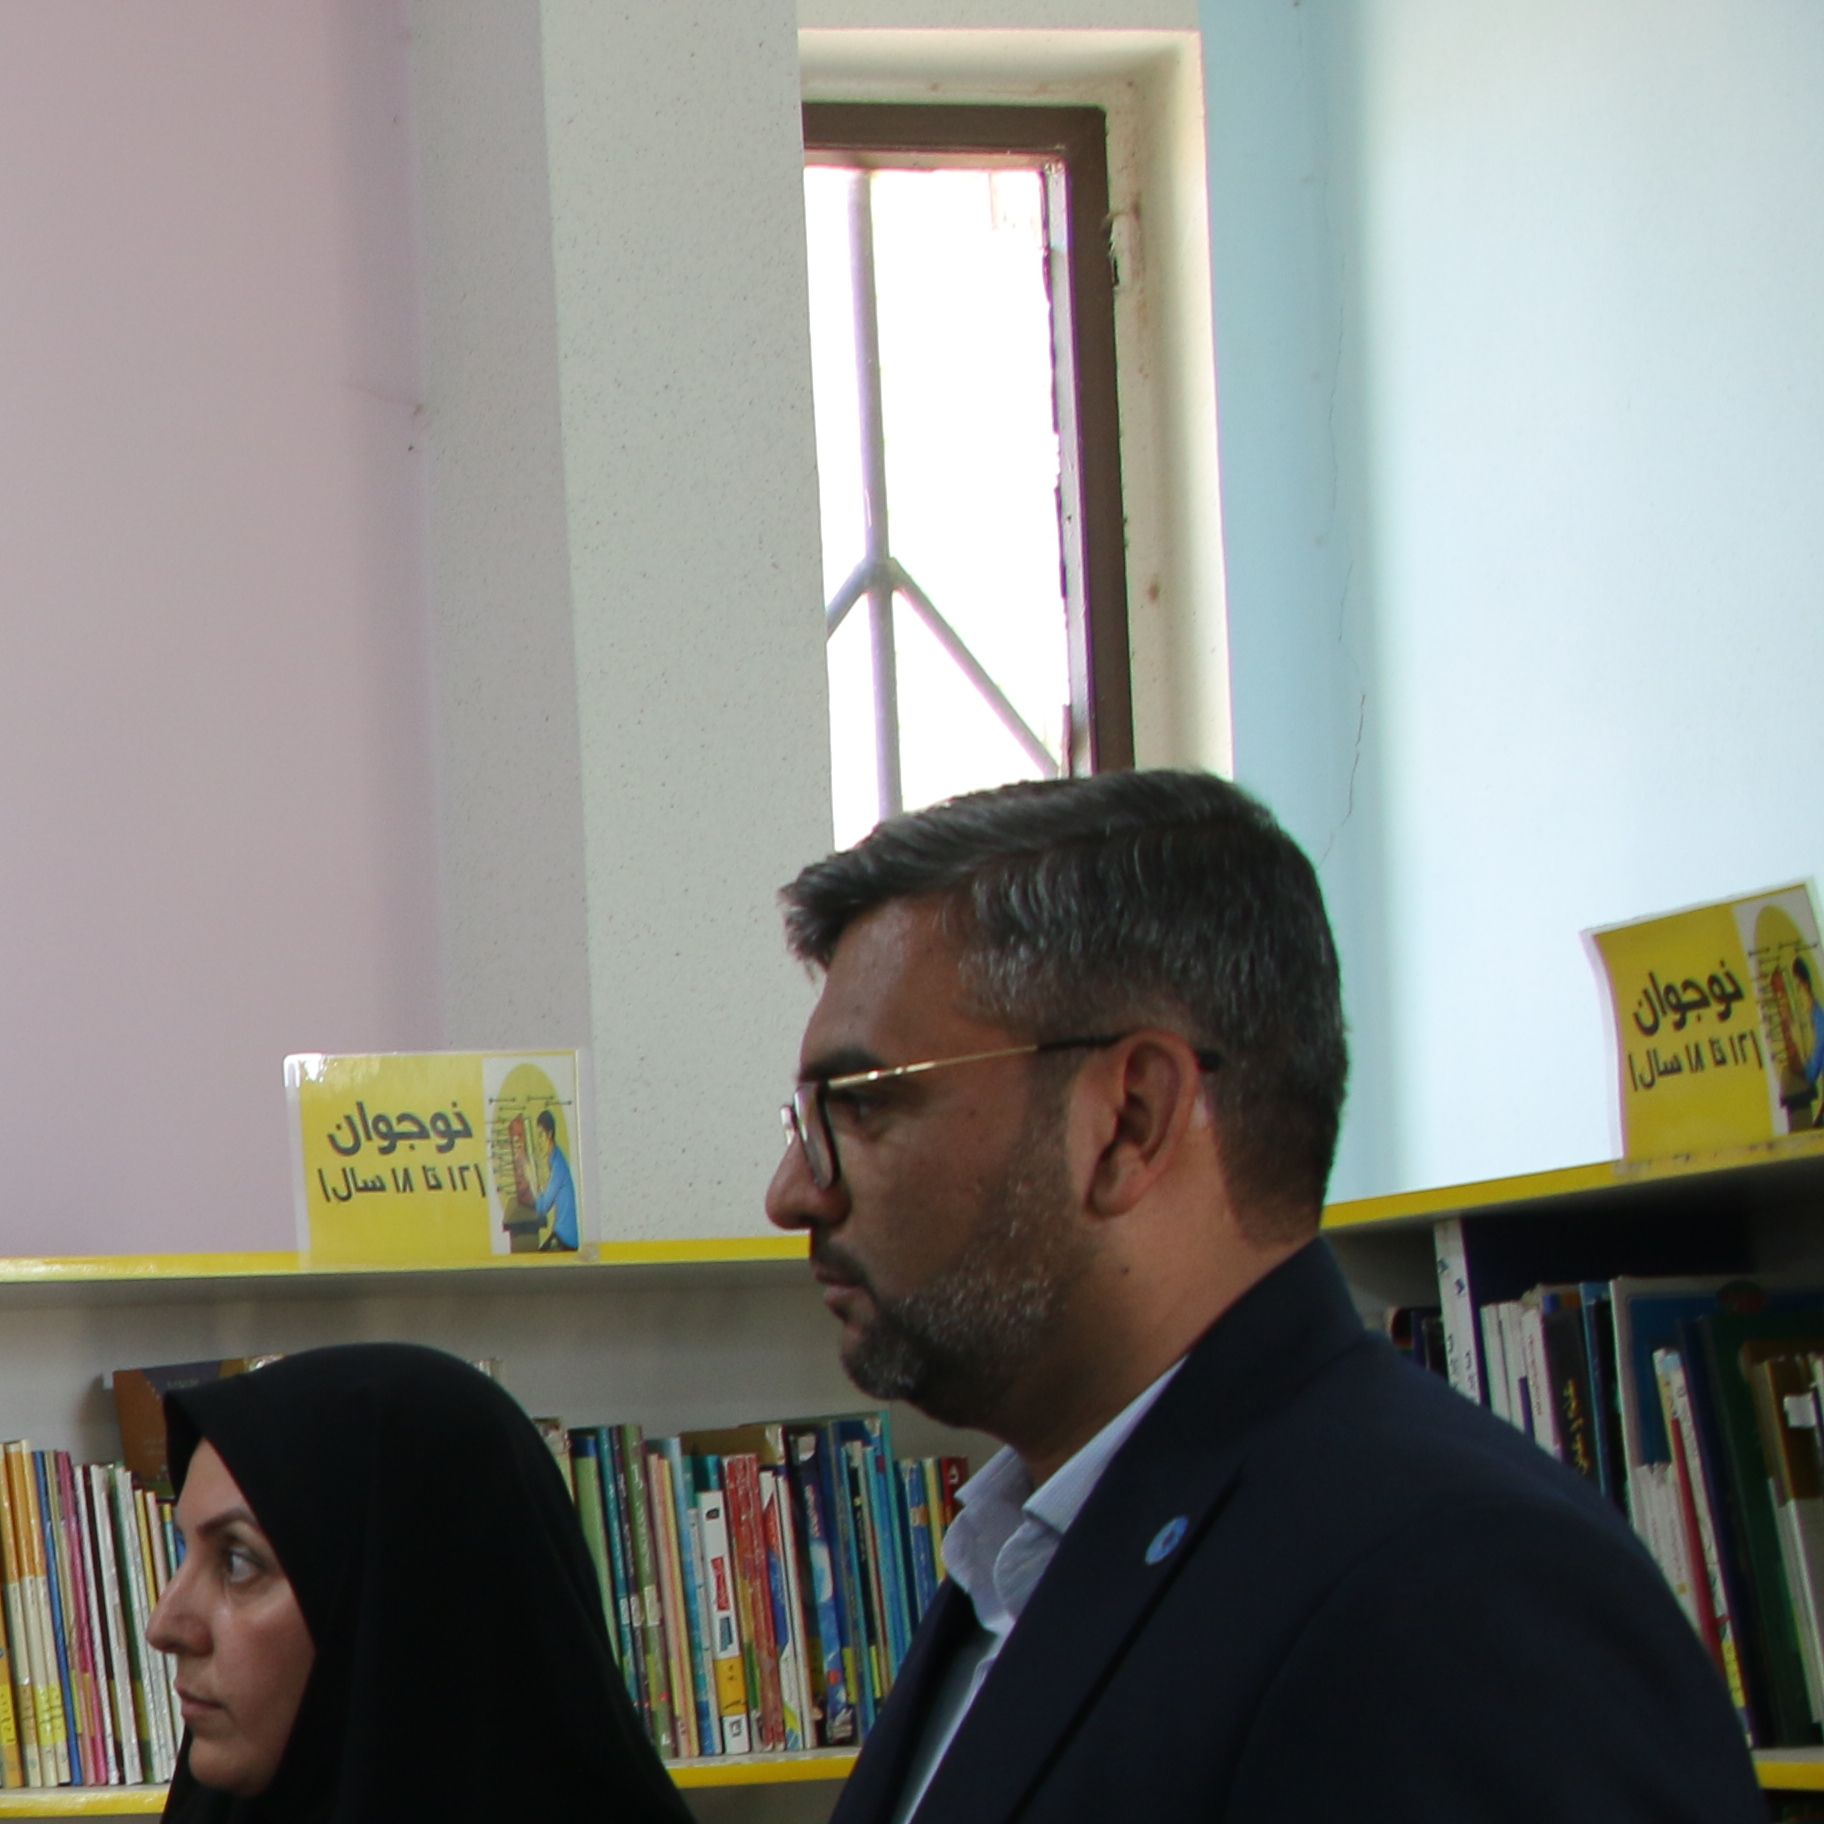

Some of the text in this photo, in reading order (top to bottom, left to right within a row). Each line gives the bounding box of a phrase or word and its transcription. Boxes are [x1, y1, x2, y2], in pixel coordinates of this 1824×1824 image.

[1633, 957, 1744, 1036] نوجوان
[1686, 1041, 1705, 1074] ۱۸
[1709, 1036, 1727, 1067] تا
[327, 1100, 474, 1157] نوجوان
[391, 1167, 414, 1194] ۱۸
[422, 1164, 443, 1191] تا
